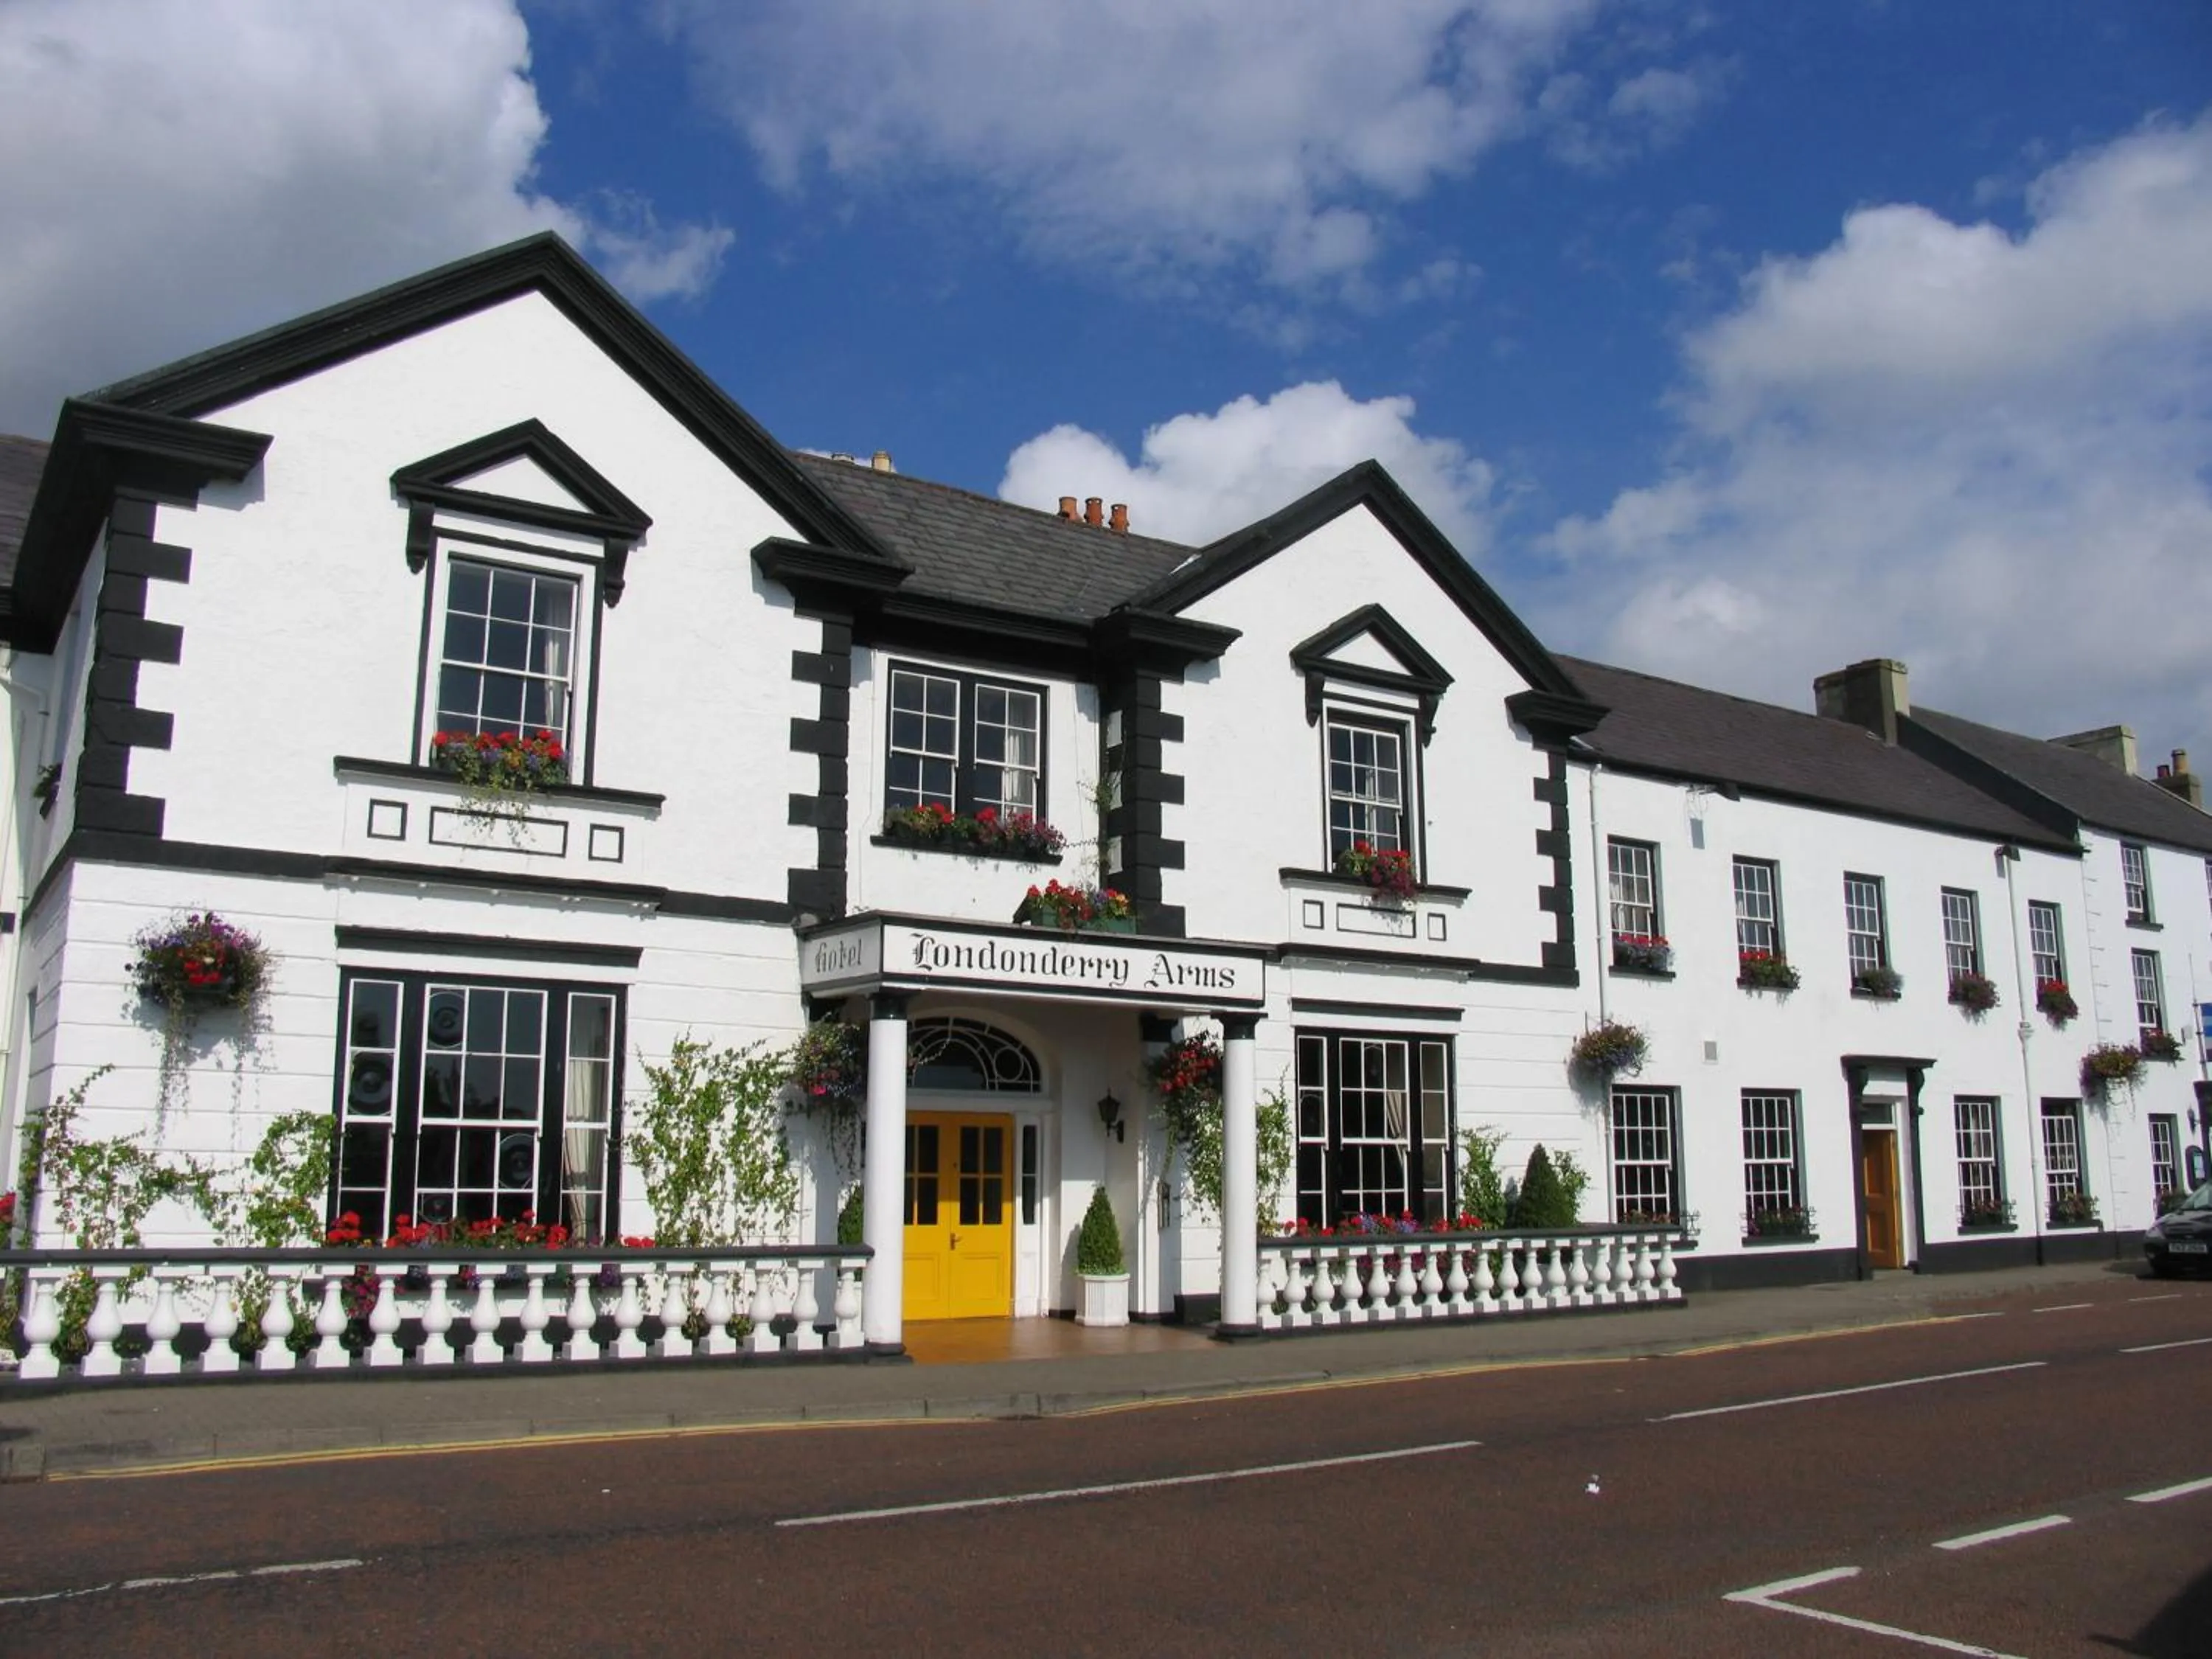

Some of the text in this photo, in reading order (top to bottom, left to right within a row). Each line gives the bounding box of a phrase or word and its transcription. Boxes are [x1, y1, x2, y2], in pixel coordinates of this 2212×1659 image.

[815, 938, 862, 973] Hotel
[911, 933, 1235, 989] Londonderry Arms
